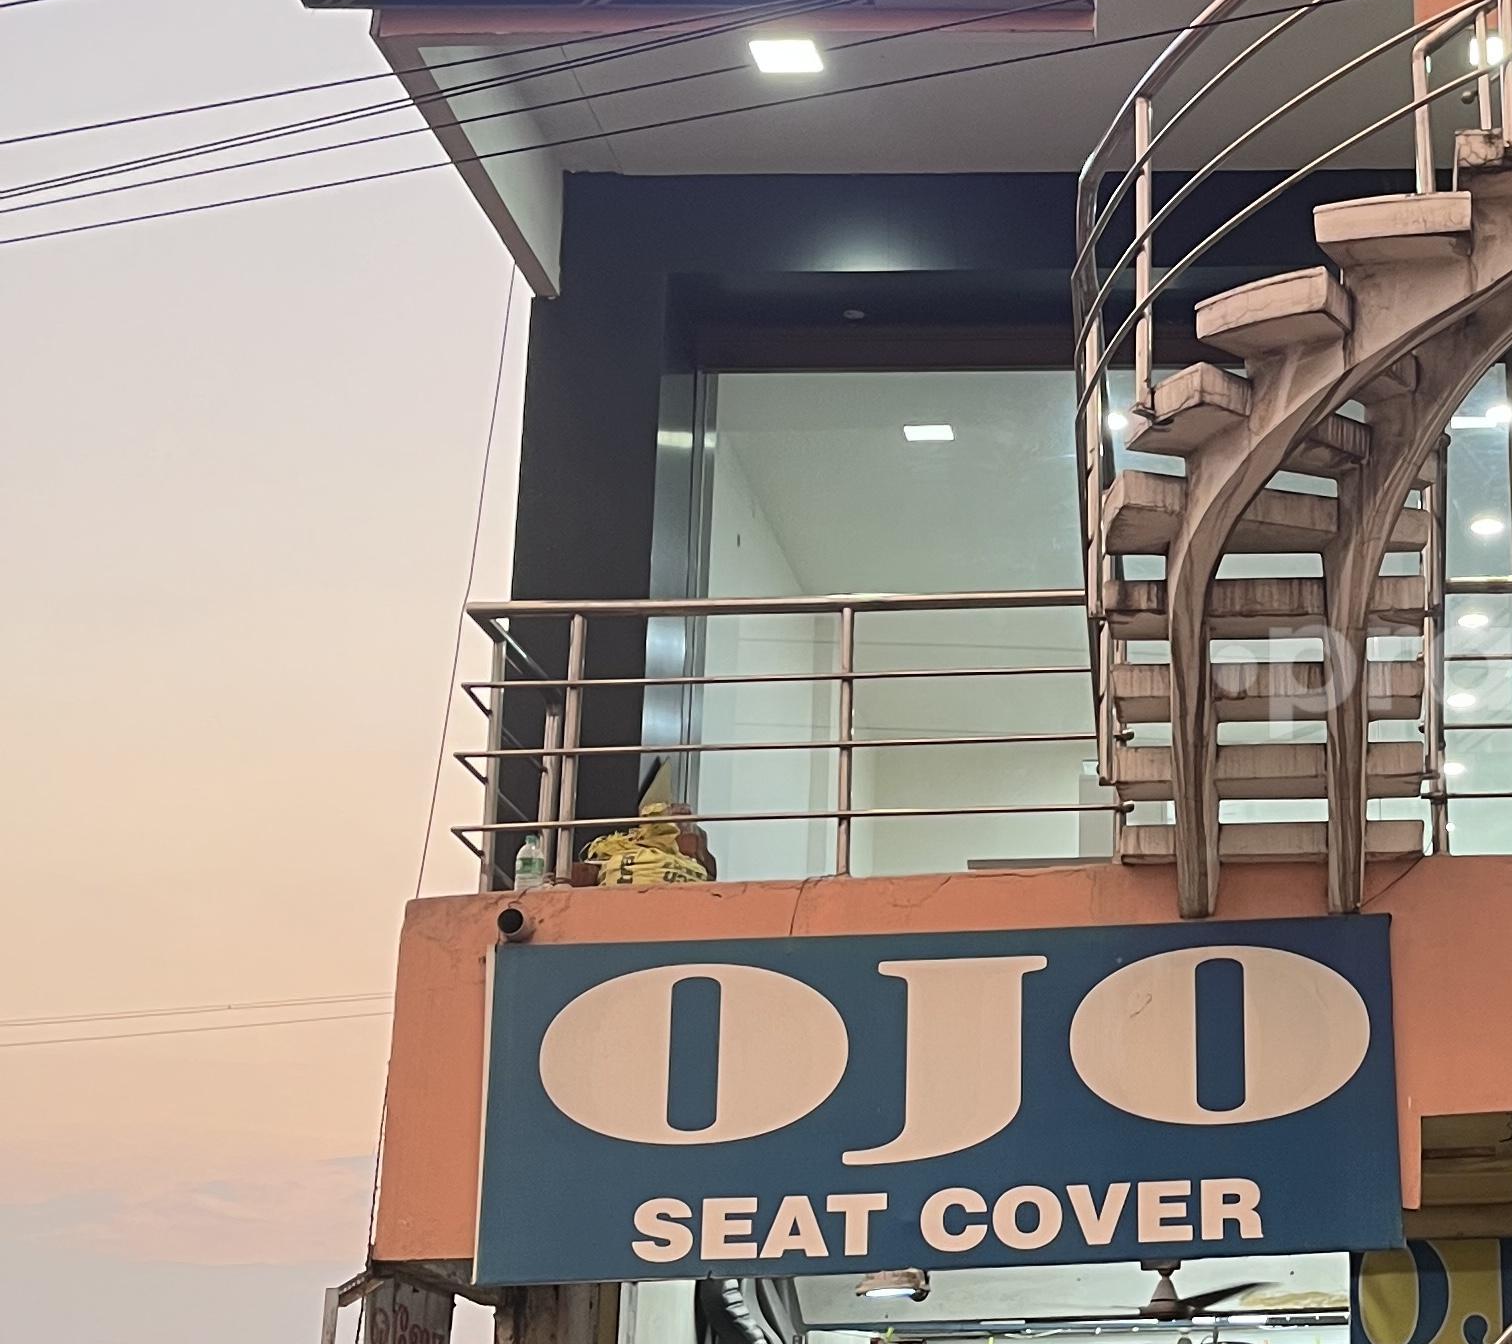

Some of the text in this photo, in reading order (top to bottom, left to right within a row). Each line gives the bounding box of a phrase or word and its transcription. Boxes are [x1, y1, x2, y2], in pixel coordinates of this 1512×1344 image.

[538, 944, 1372, 1166] OJO
[631, 1176, 1265, 1264] SEAT COVER
